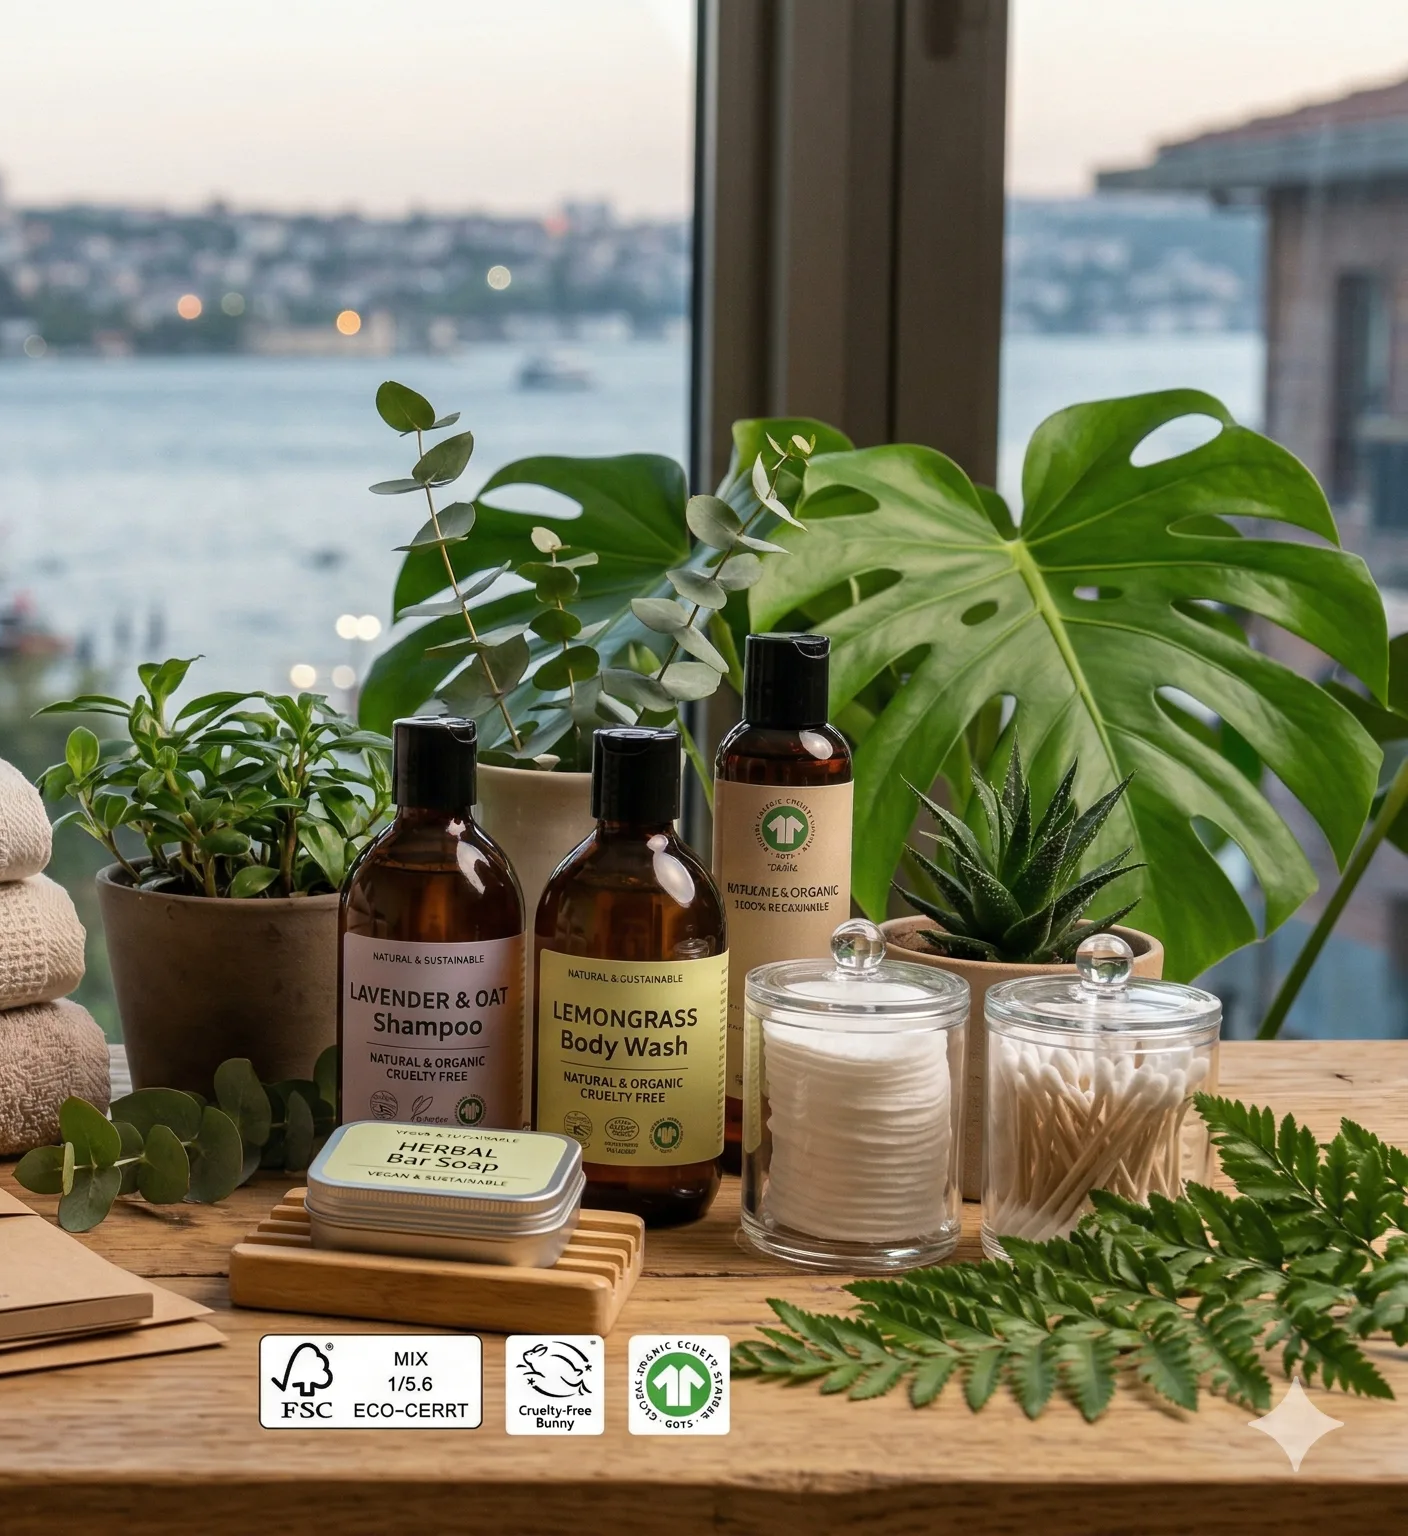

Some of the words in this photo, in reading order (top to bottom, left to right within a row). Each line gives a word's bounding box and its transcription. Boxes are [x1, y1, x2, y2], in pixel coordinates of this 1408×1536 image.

[780, 888, 789, 898] &
[790, 885, 839, 898] ORGANIC
[373, 952, 412, 963] NATURAL
[415, 956, 421, 964] &
[425, 955, 484, 964] SUSTAINABLE
[568, 969, 608, 982] NATURAL
[350, 982, 449, 1009] LAVENDER
[455, 992, 470, 1008] &
[475, 987, 508, 1007] OAT
[553, 1001, 698, 1028] LEMONGRASS
[373, 1012, 482, 1041] Shampoo
[561, 1029, 618, 1060] Body
[624, 1035, 688, 1057] Wash
[370, 1053, 422, 1067] NATURAL
[423, 1058, 432, 1068] &
[435, 1056, 485, 1068] ORGANIC
[386, 1069, 436, 1081] CRUELTY
[439, 1071, 467, 1081] FREE
[564, 1071, 615, 1088] NATURAL
[619, 1078, 627, 1088] &
[630, 1077, 683, 1089] ORGANIC
[581, 1088, 632, 1102] CRUELTY
[636, 1092, 665, 1103] FREE
[398, 1142, 498, 1159] HERBAL
[387, 1153, 431, 1166] Bar
[435, 1157, 499, 1173] Soap
[368, 1170, 410, 1179] VEGAN
